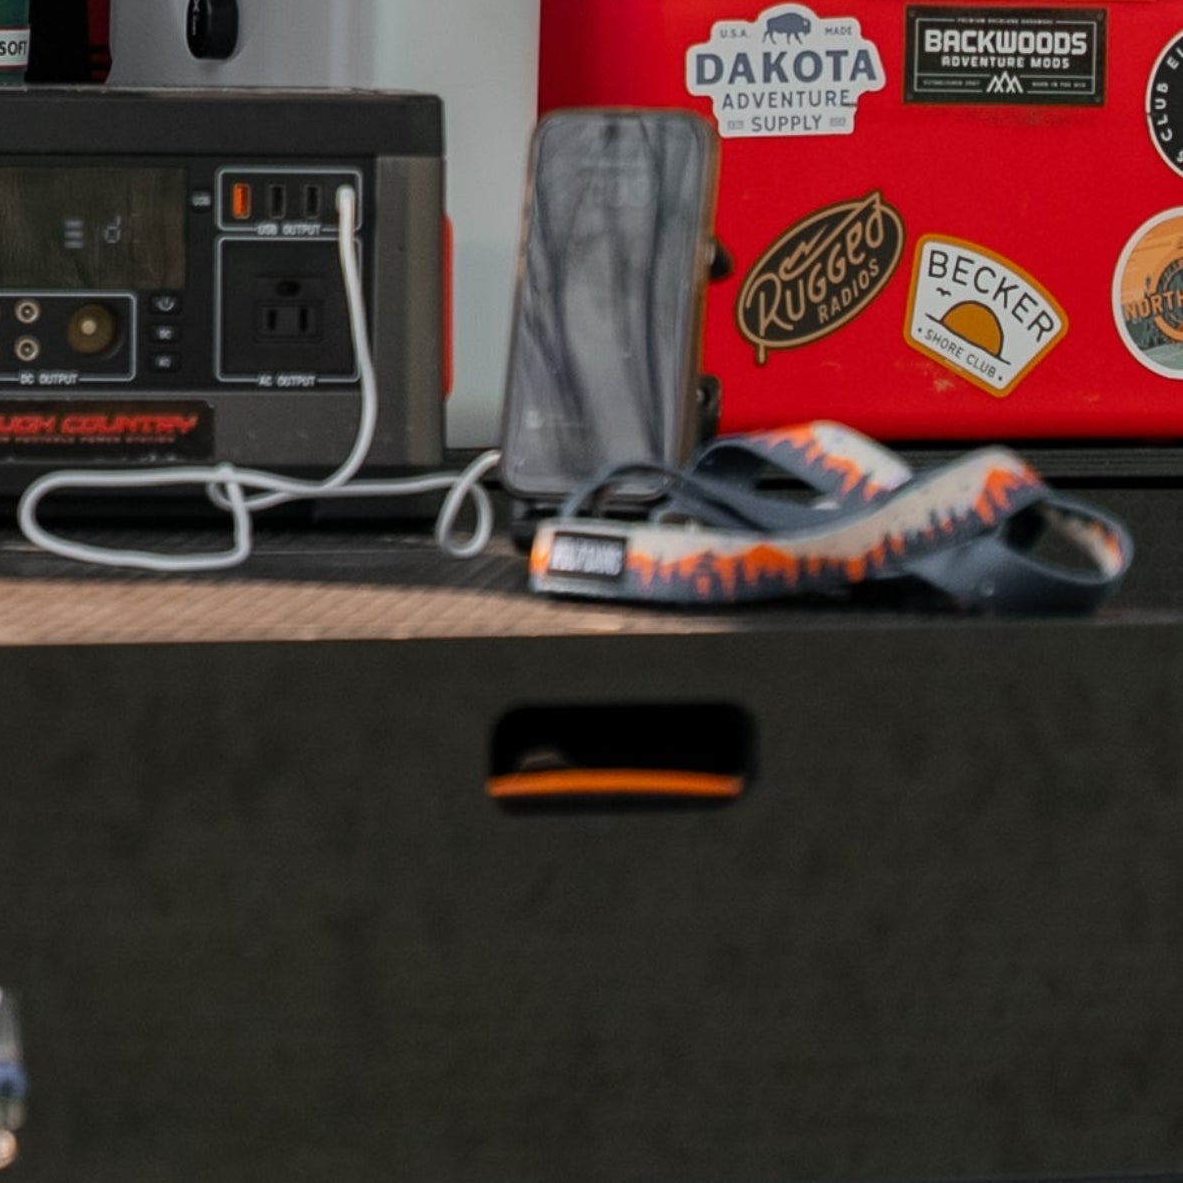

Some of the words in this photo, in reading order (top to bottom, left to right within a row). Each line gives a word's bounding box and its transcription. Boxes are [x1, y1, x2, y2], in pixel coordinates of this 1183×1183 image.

[825, 26, 854, 36] MADE
[924, 29, 1087, 55] BACKWOODS
[696, 49, 877, 85] DAKOTA
[941, 56, 1025, 68] ADVENTURE
[1030, 57, 1070, 69] MODS
[722, 90, 852, 110] ADVENTURE
[1154, 82, 1173, 142] CLUB
[751, 116, 822, 132] SUPPLY
[282, 223, 320, 236] OUTPUT
[818, 258, 879, 323] RADIOS
[928, 249, 1054, 343] BECKER
[924, 329, 964, 359] SHORE
[966, 354, 997, 379] CLUB
[20, 374, 35, 385] DC
[39, 374, 78, 386] OUTPUT
[259, 375, 273, 387] AC
[276, 375, 316, 387] OUTPUT
[61, 413, 199, 435] COUNTRY
